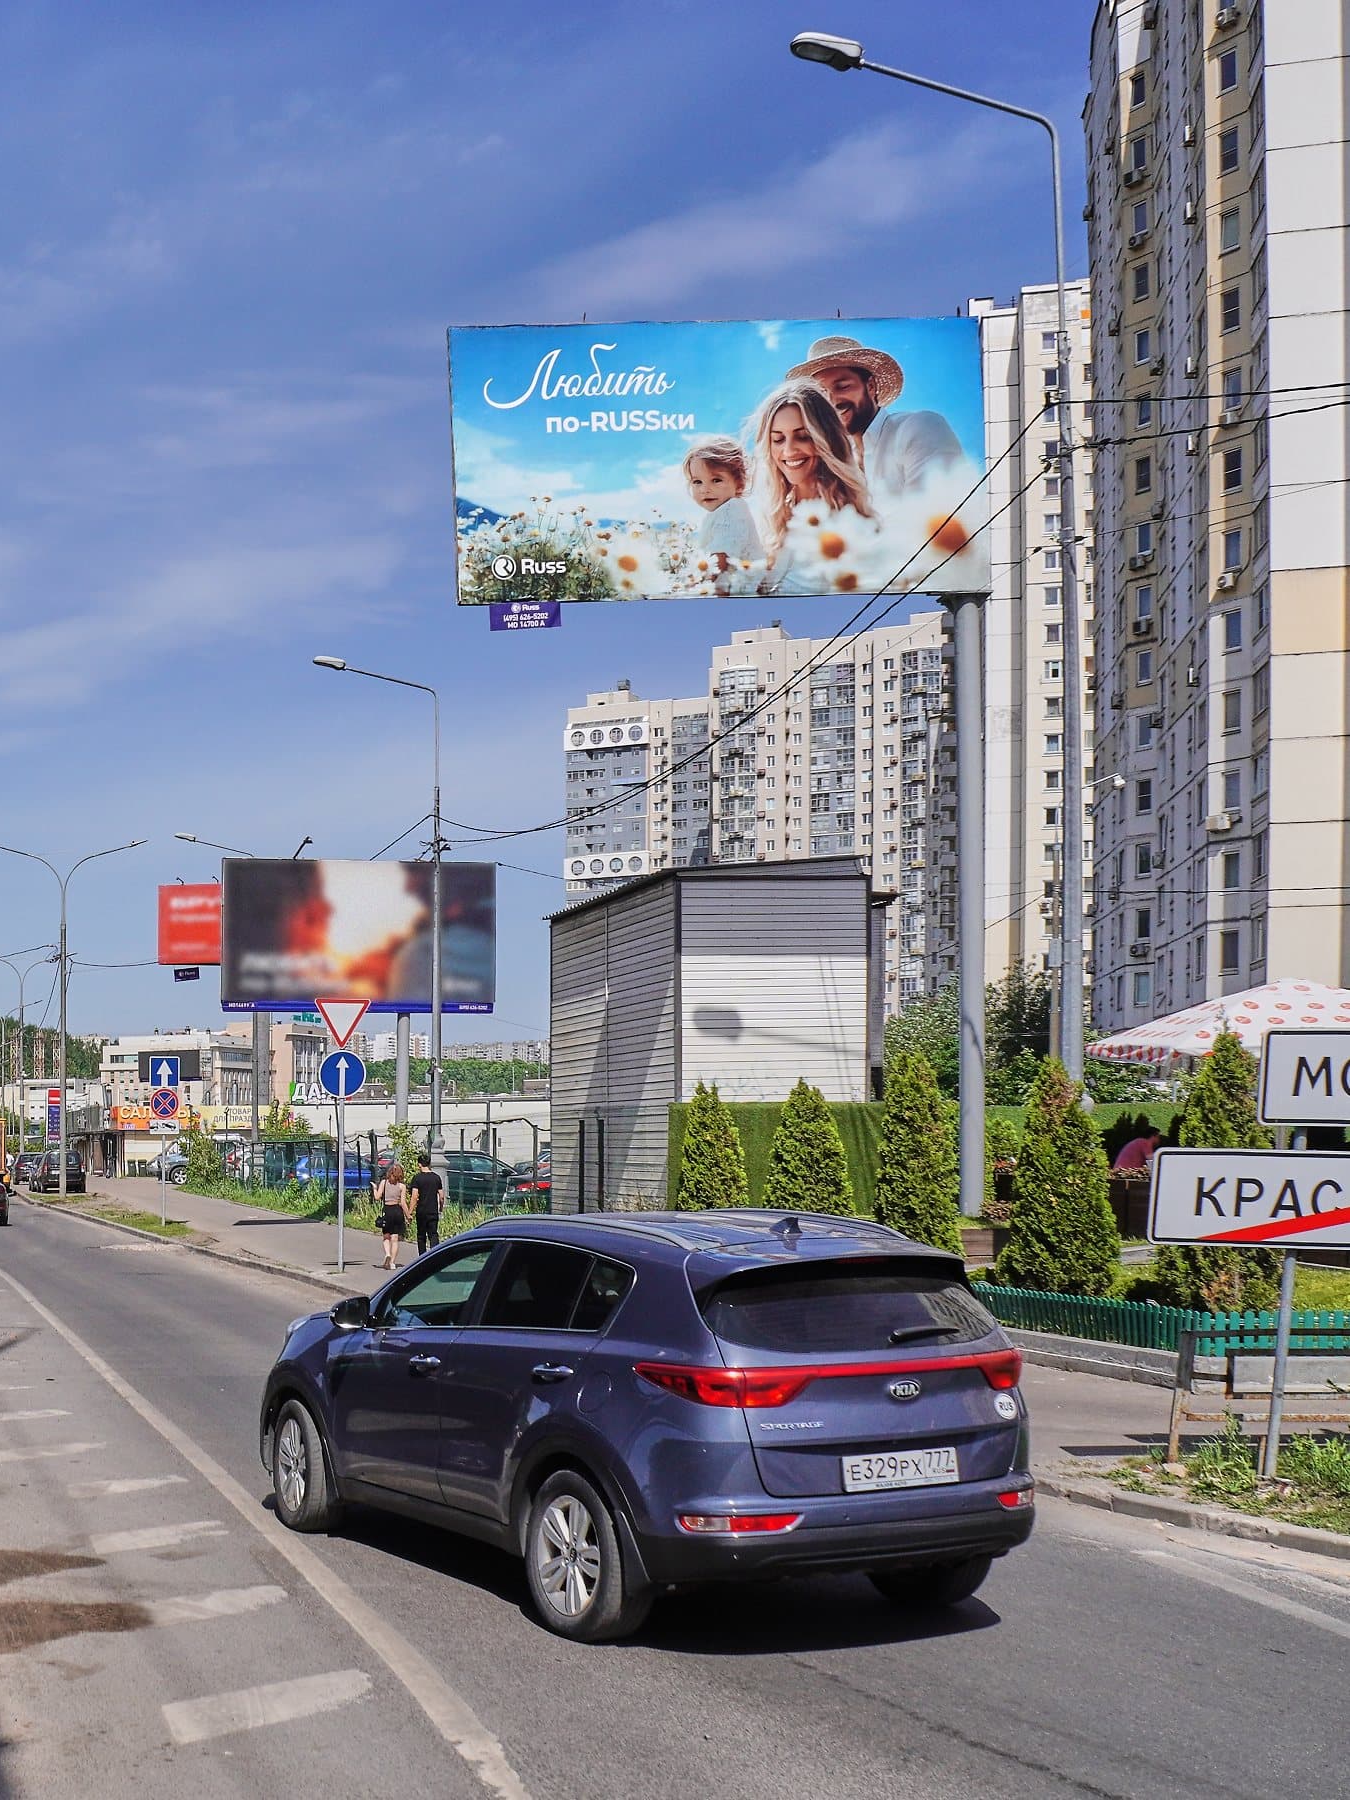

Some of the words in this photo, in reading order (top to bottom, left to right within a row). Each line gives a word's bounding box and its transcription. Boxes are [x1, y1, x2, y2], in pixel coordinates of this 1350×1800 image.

[483, 342, 676, 409] Любить
[545, 410, 695, 434] по-RUSSки
[521, 558, 567, 575] Russ
[1292, 1056, 1350, 1097] М
[119, 1106, 191, 1119] САЛЫ
[895, 1383, 916, 1396] KIA
[998, 1400, 1014, 1412] RUS
[759, 1421, 825, 1431] SPORTAGE
[924, 1450, 951, 1468] 777
